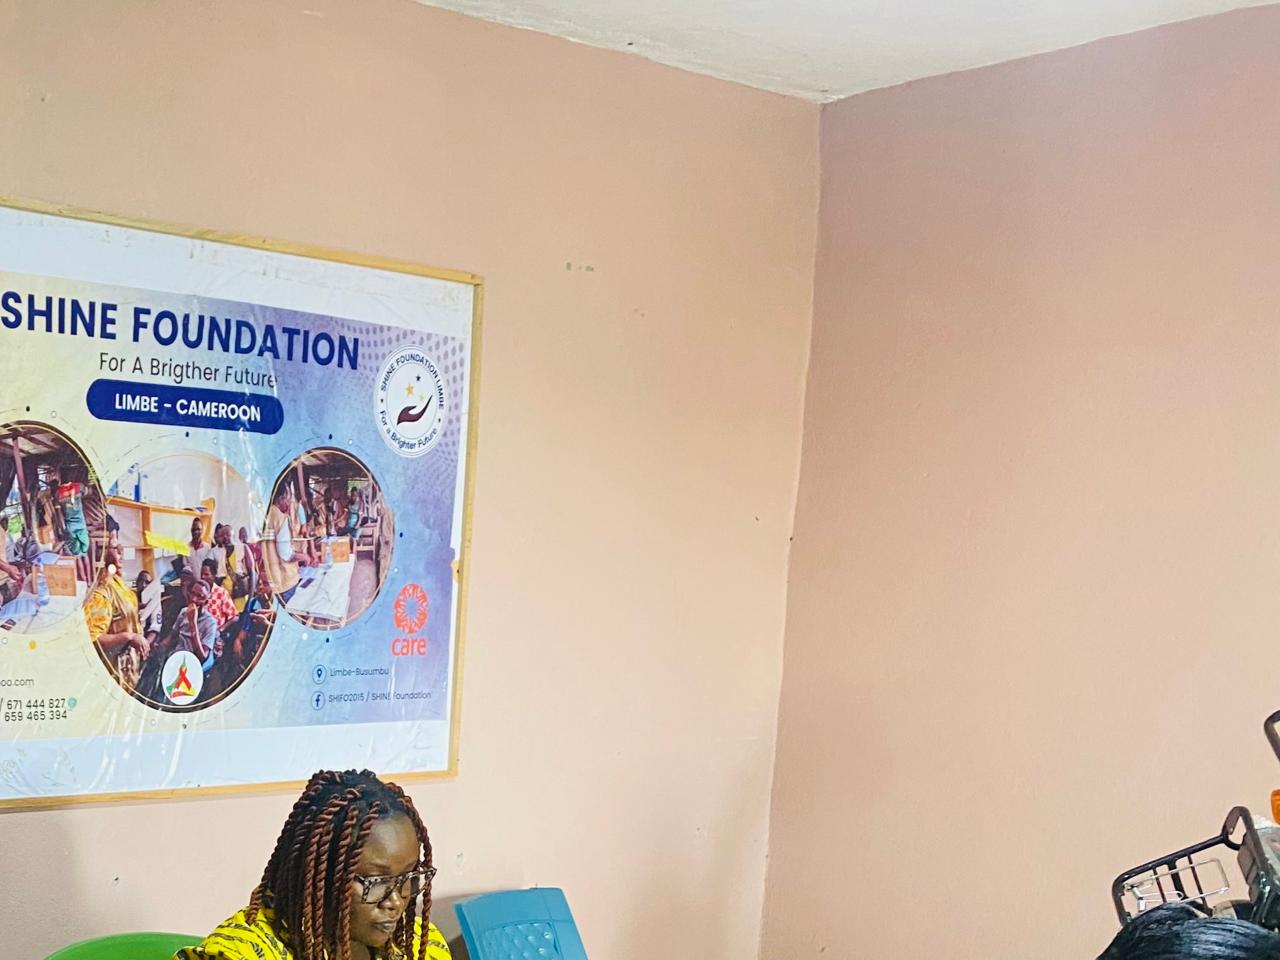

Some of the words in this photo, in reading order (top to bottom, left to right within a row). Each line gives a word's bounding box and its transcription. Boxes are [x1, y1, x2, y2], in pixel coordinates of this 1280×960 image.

[1, 290, 118, 340] SHINE
[132, 306, 359, 370] FOUNDATION
[99, 352, 125, 372] For
[131, 356, 145, 375] A
[150, 358, 220, 384] Brigther
[225, 366, 278, 390] Future
[380, 364, 397, 392] SHINE
[395, 353, 439, 382] FOUNDATION
[114, 393, 159, 413] LIMBE
[176, 399, 261, 422] CAMEROON
[379, 410, 388, 427] For
[390, 432, 417, 450] Brighter
[417, 428, 438, 449] Future
[392, 637, 427, 656] care
[4, 711, 24, 722] 659
[26, 710, 46, 721] 465
[49, 709, 68, 720] 394
[6, 699, 22, 710] 671
[26, 699, 45, 709] 444
[48, 698, 66, 709] 827
